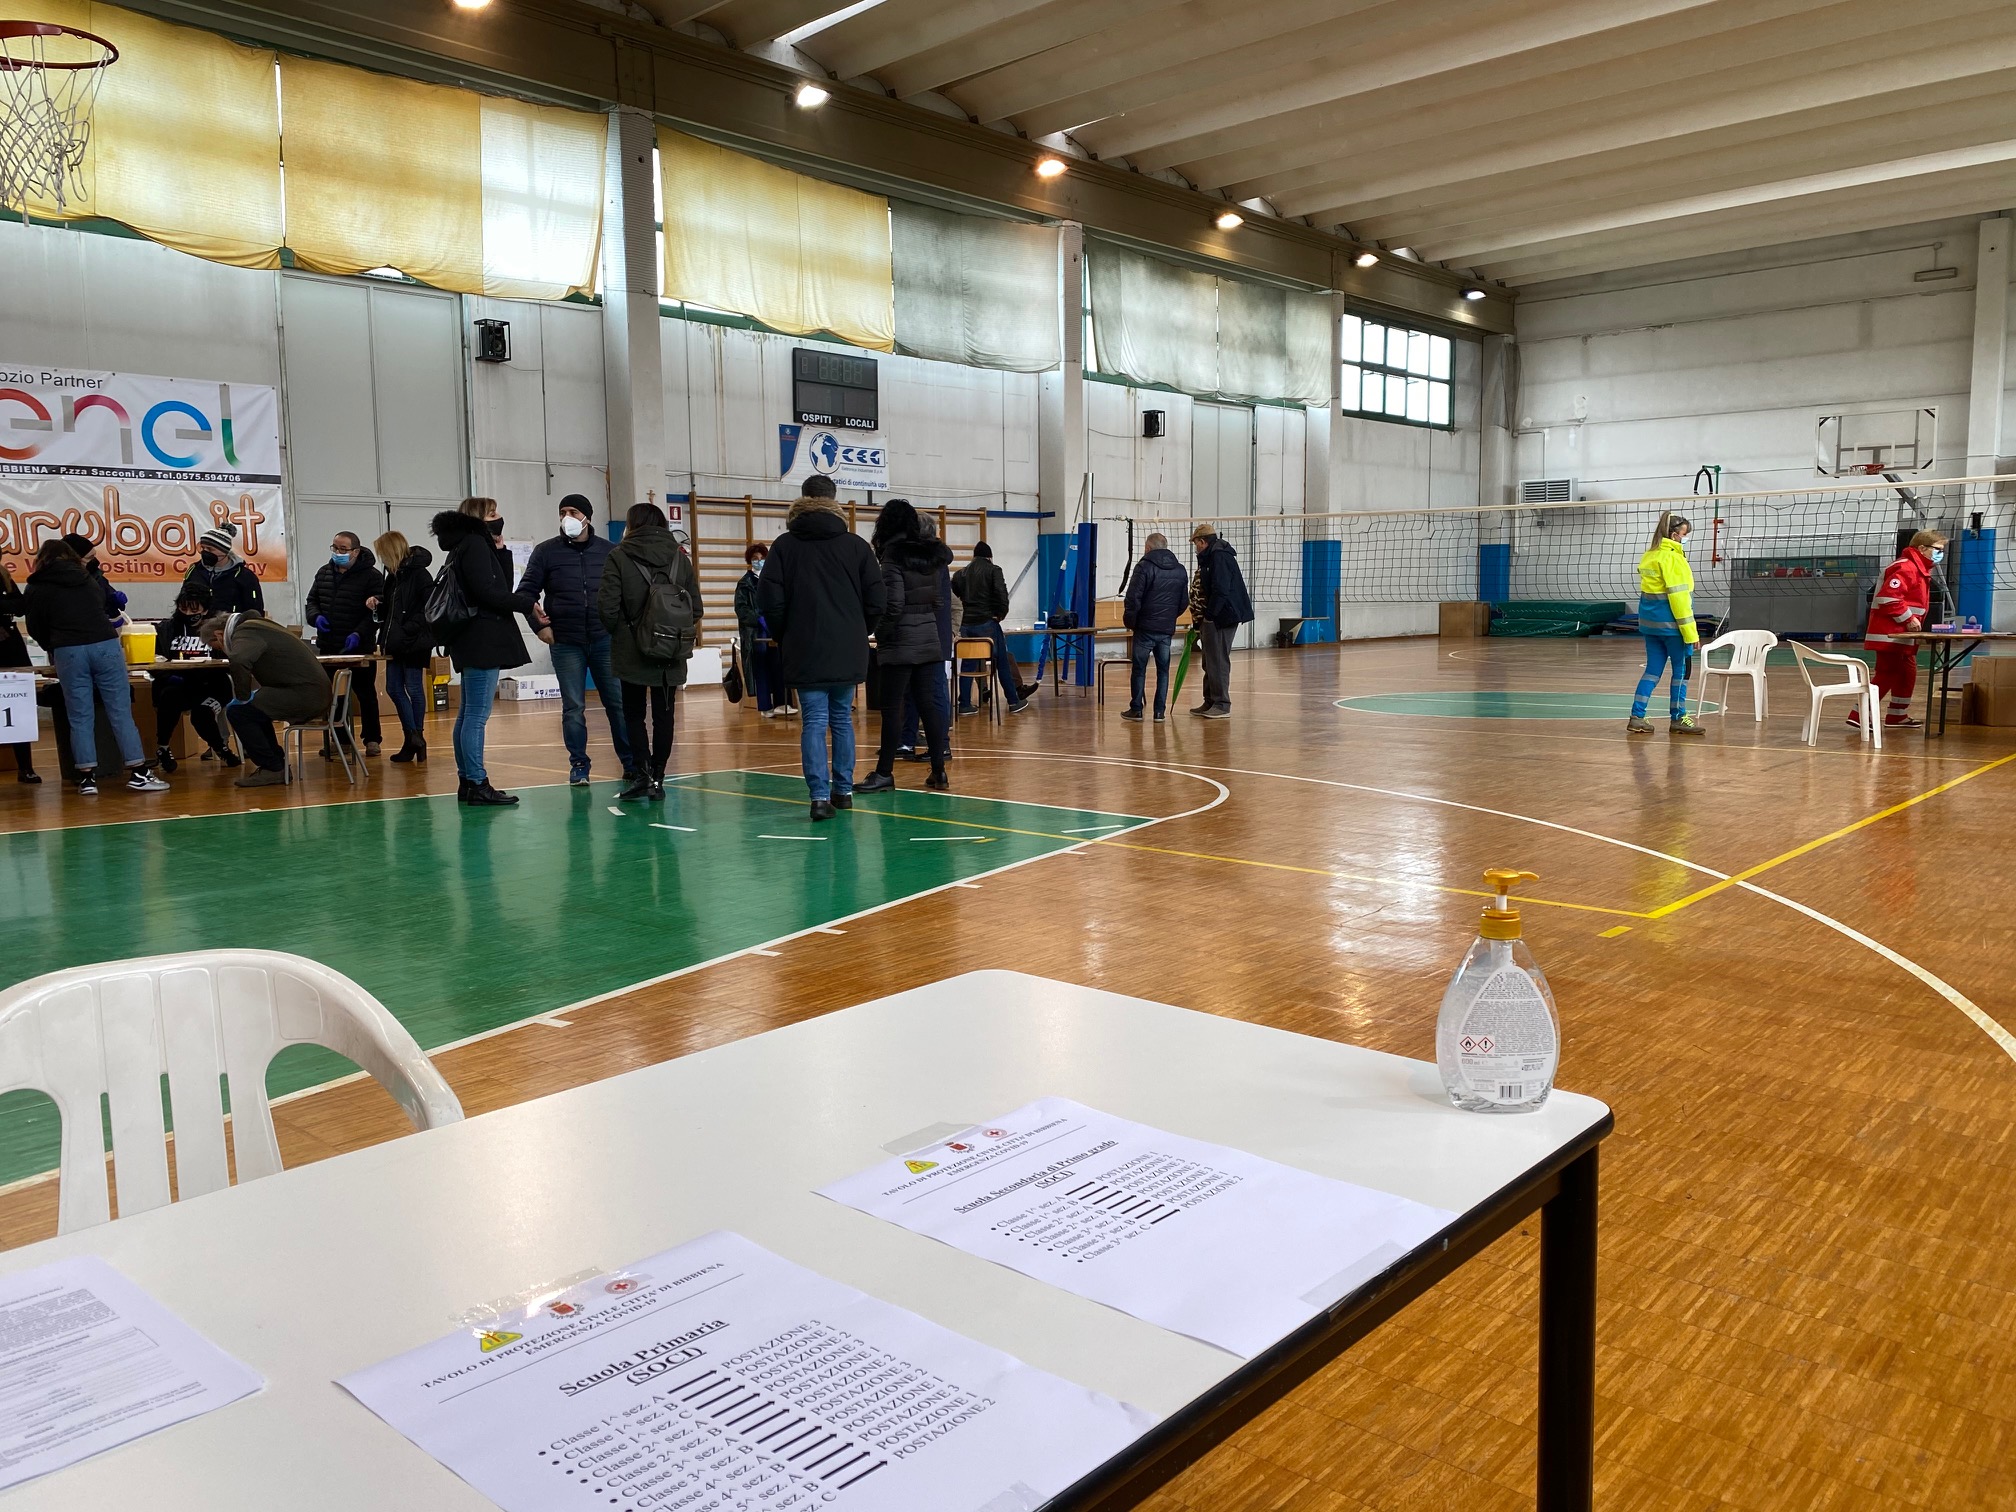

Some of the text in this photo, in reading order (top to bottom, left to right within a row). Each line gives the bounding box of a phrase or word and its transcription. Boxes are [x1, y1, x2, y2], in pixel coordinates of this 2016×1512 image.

[40, 371, 104, 389] Partner
[801, 413, 875, 429] OSPITI LOCALI
[60, 466, 87, 476] P.zza
[156, 470, 241, 482] Tel.0575.594706
[100, 558, 165, 576] osting
[2, 707, 15, 728] 1
[953, 1140, 1118, 1213] Scuola Secondaria di Primo grado
[996, 1213, 1027, 1228] Classe
[1095, 1154, 1152, 1181] POSTAZIONE
[1010, 1218, 1041, 1233] Classe
[1109, 1158, 1166, 1185] POSTAZIONE
[1024, 1223, 1055, 1238] Classe
[1122, 1162, 1179, 1190] POSTAZIONE
[1034, 1170, 1075, 1189] (SOCI)
[1038, 1228, 1070, 1243] Classe
[1137, 1166, 1194, 1194] POSTAZIONE
[1052, 1233, 1084, 1248] Classe
[1150, 1170, 1208, 1199] POSTAZIONE
[1067, 1238, 1099, 1254] Classe
[1165, 1174, 1222, 1203] POSTAZIONE
[1082, 1244, 1114, 1260] Classe
[1180, 1179, 1237, 1208] POSTAZIONE
[421, 1364, 477, 1388] TAVOLO
[479, 1357, 495, 1366] DI
[496, 1323, 575, 1359] PROTEZIONE
[578, 1306, 620, 1324] CIVILE
[658, 1284, 672, 1292] DI
[672, 1263, 723, 1286] BIBBIENA
[525, 1298, 656, 1355] EMERGENZA COVID-19
[559, 1320, 724, 1394] Scuola Primaria
[550, 1426, 599, 1450] Classe
[622, 1404, 650, 1417] sez.
[652, 1395, 665, 1404] A
[721, 1325, 811, 1369] POSTAZIONE
[563, 1435, 613, 1459] Classe
[636, 1412, 664, 1426] sez.
[663, 1402, 678, 1411] B
[736, 1331, 826, 1376] POSTAZIONE
[577, 1443, 627, 1469] Classe
[650, 1420, 679, 1434] sez.
[678, 1410, 692, 1419] C
[750, 1337, 841, 1383] POSTAZIONE
[838, 1331, 851, 1339] 2
[626, 1347, 706, 1385] (SOCI)
[592, 1452, 642, 1478] Classe
[664, 1429, 693, 1443] sez.
[694, 1420, 709, 1429] A
[764, 1345, 855, 1391] POSTAZIONE
[853, 1338, 865, 1346] 3
[606, 1461, 657, 1487] Classe
[679, 1438, 708, 1452] sez.
[706, 1427, 722, 1437] B
[780, 1351, 871, 1399] POSTAZIONE
[621, 1471, 672, 1497] Classe
[694, 1446, 723, 1461] sez.
[724, 1437, 739, 1447] A
[794, 1359, 886, 1407] POSTAZIONE
[883, 1353, 896, 1362] 2
[636, 1480, 687, 1507] Classe
[709, 1456, 739, 1471] sez.
[737, 1445, 753, 1455] B
[810, 1367, 902, 1415] POSTAZIONE
[899, 1361, 911, 1369] 3
[725, 1465, 755, 1480] sez.
[755, 1455, 770, 1465] A
[825, 1374, 917, 1424] POSTAZIONE
[914, 1368, 928, 1376] 2
[742, 1474, 771, 1490] sez.
[769, 1463, 785, 1473] B
[842, 1381, 934, 1432] POSTAZIONE
[932, 1375, 944, 1383] 1
[758, 1484, 788, 1500] sez.
[788, 1474, 803, 1484] A
[858, 1390, 950, 1441] POSTAZIONE
[947, 1384, 960, 1392] 3
[775, 1494, 805, 1510] sez.
[802, 1482, 819, 1492] B
[876, 1398, 968, 1449] POSTAZIONE
[820, 1397, 996, 1502] C POSTAZIONE 2
